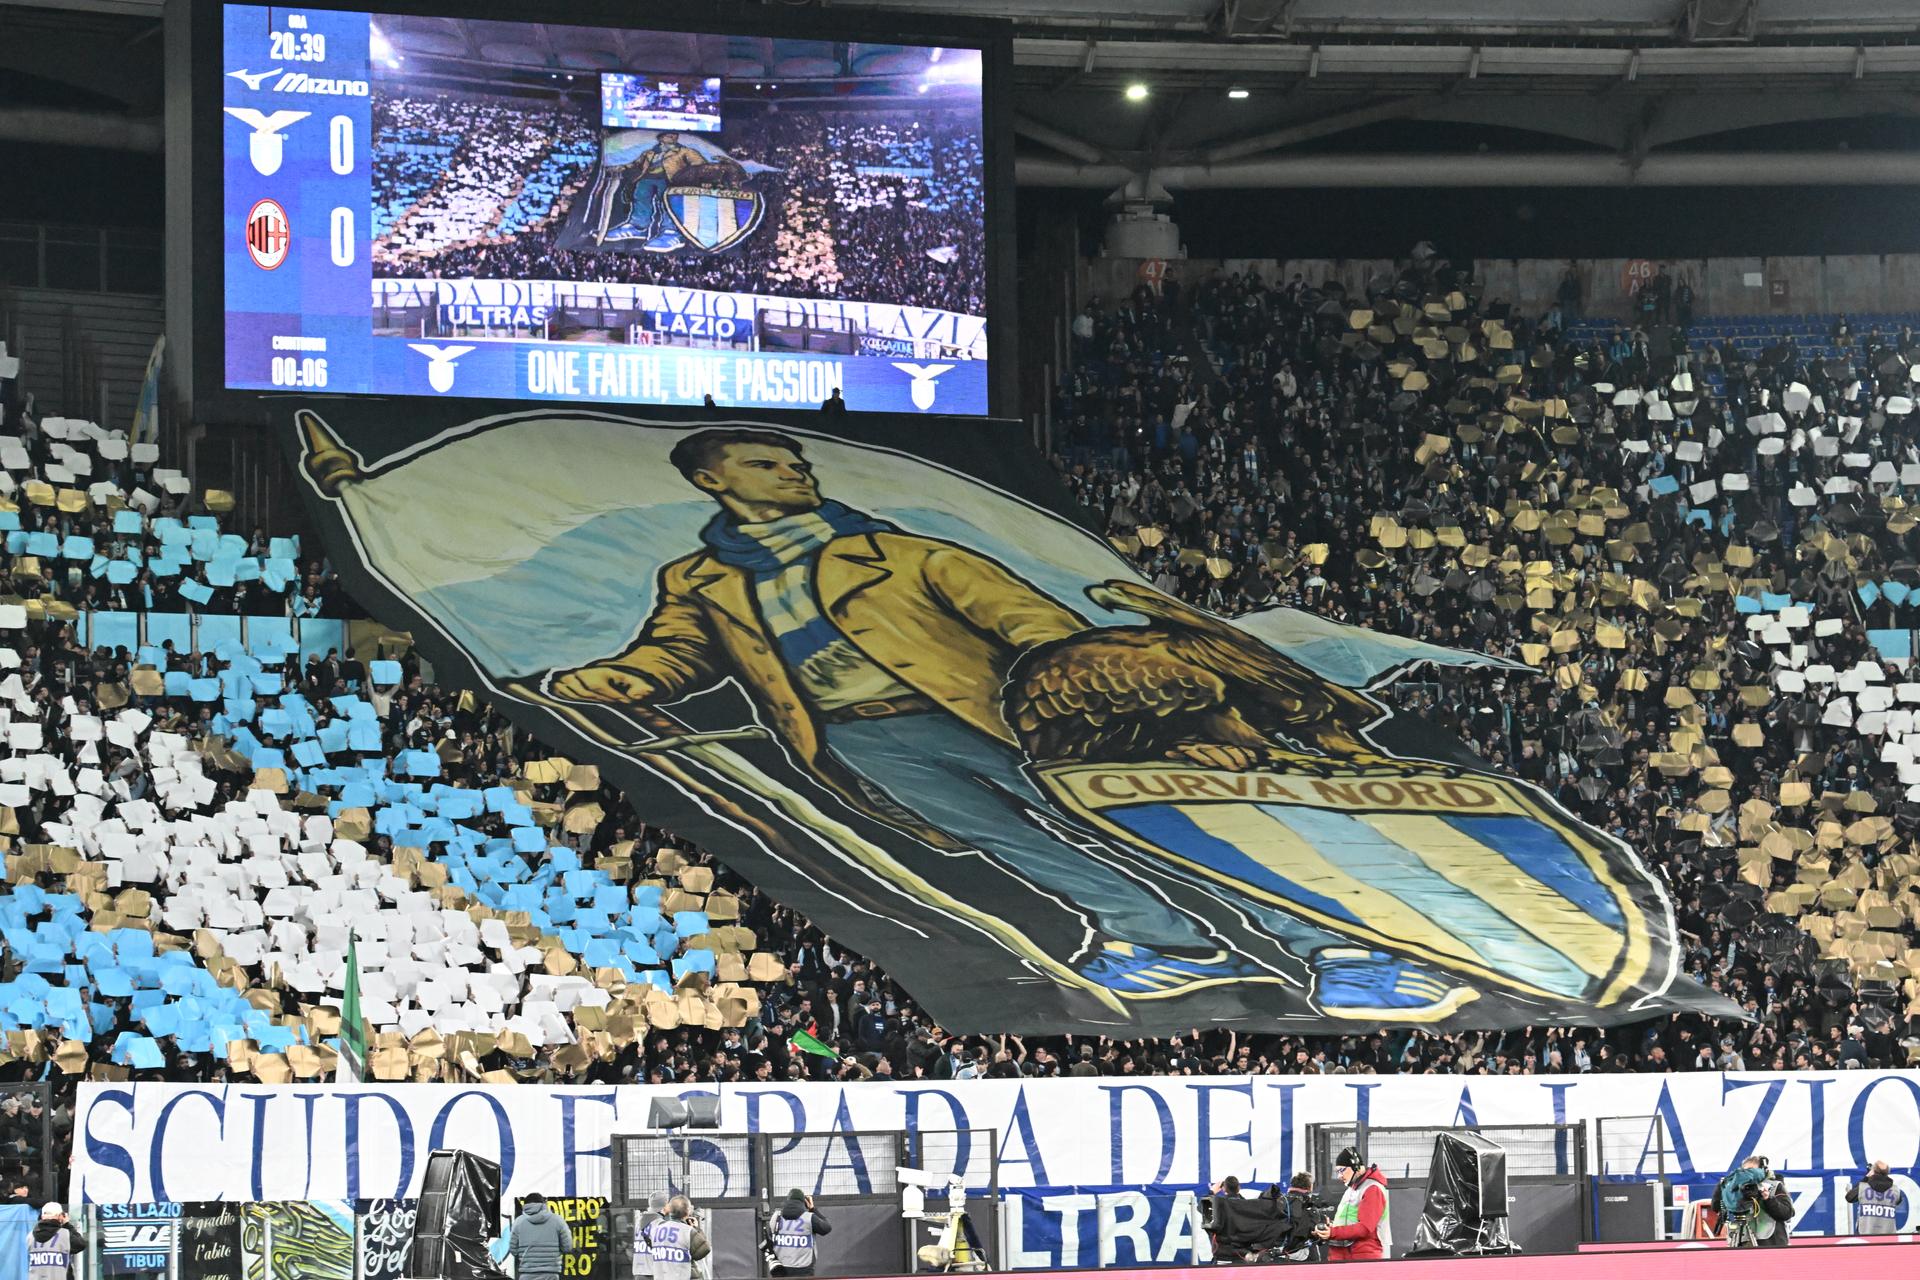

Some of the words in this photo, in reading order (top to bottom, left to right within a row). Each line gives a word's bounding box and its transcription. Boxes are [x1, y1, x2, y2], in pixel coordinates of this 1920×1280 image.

[270, 31, 326, 62] 20:39
[330, 114, 355, 176] 0
[331, 206, 356, 267] 0
[1146, 261, 1168, 278] 47
[1628, 261, 1651, 279] 46
[449, 306, 548, 326] ULTRAS
[655, 313, 736, 338] LAZIO
[271, 356, 328, 388] 00:06
[528, 350, 581, 395] ONE
[588, 353, 668, 404] FAITH,
[676, 356, 729, 400] ONE
[736, 358, 844, 404] PASSION
[1087, 773, 1301, 801] CURVA
[1309, 779, 1500, 809] NORD
[80, 1082, 516, 1203] SCUDO
[666, 1082, 1051, 1197] SPADA
[1540, 1072, 1920, 1177] LAZIO
[136, 1201, 182, 1218] LAZIO
[194, 1205, 236, 1239] gradito
[1862, 1204, 1896, 1218] PHOTO
[572, 1225, 603, 1249] HE'
[653, 1226, 680, 1244] 105
[1005, 1189, 1263, 1268] LTRA
[123, 1254, 165, 1268] TIBUR
[560, 1253, 597, 1276] RO'
